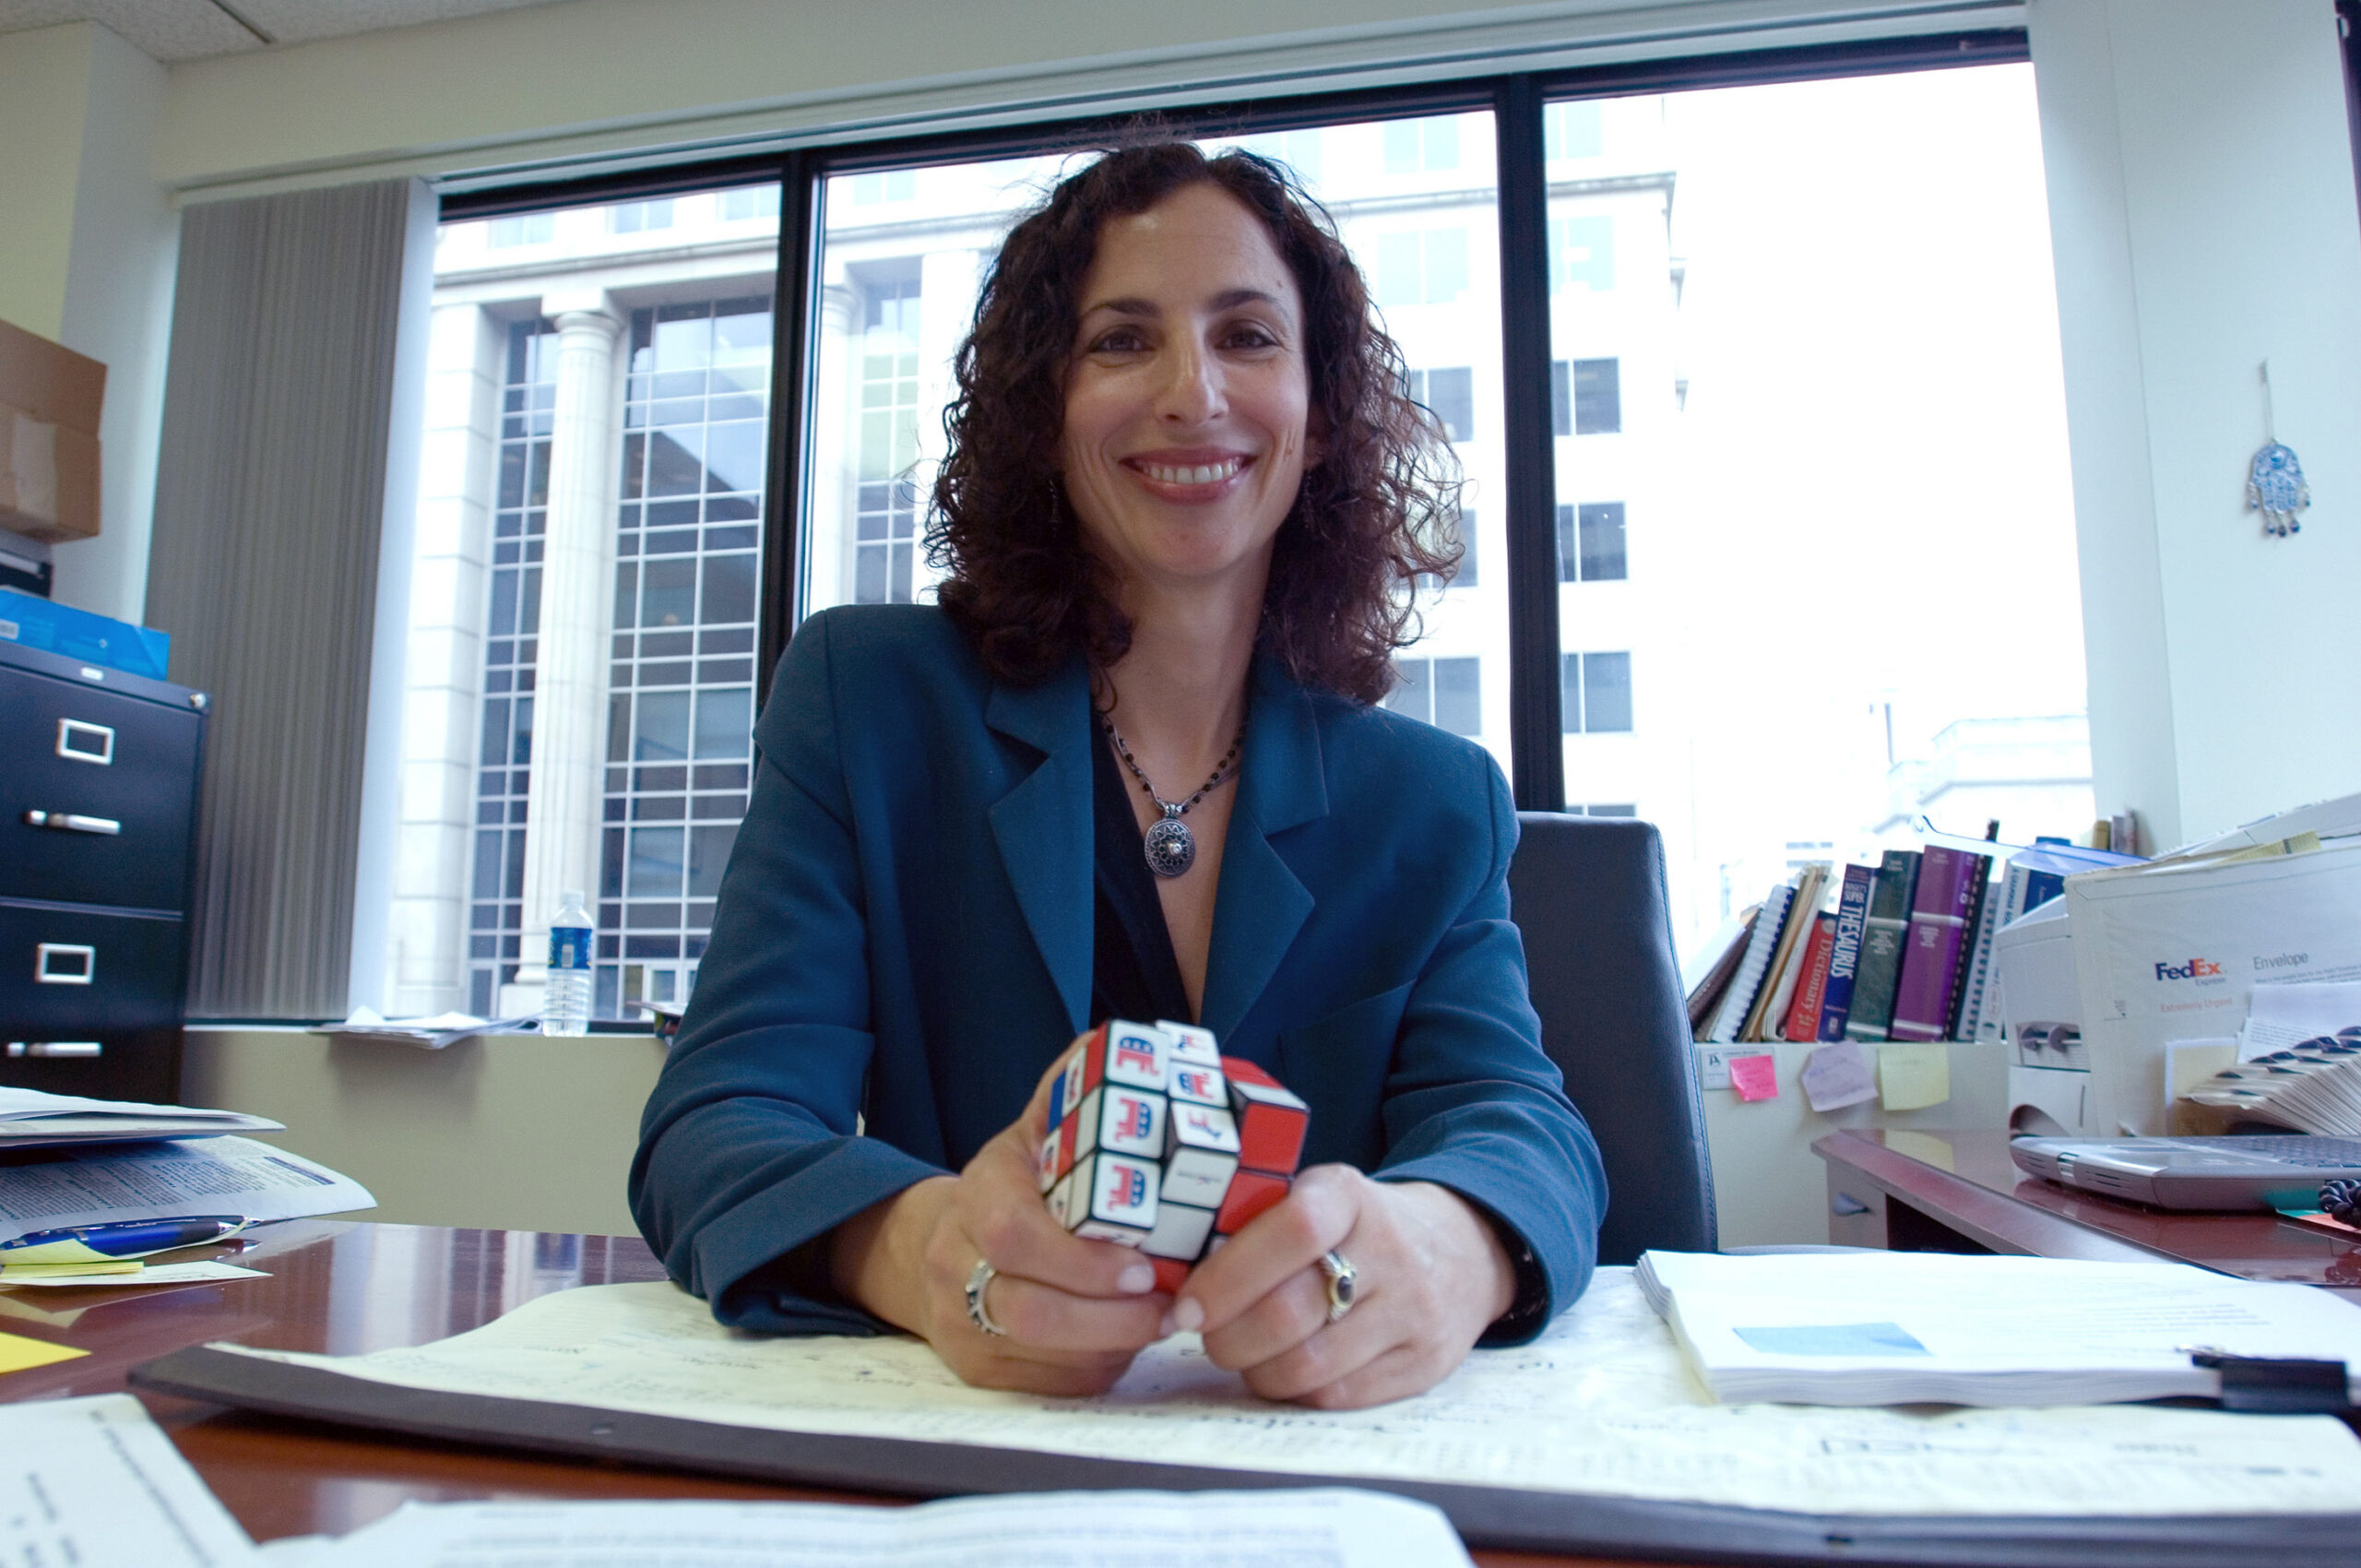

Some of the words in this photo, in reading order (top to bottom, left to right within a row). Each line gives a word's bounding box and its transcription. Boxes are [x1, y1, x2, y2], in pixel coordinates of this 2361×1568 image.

[1801, 938, 1834, 1014] Dictionary
[1830, 905, 1864, 980] THESAURUS
[2154, 957, 2222, 980] FedEx
[2253, 952, 2308, 970] Envelope
